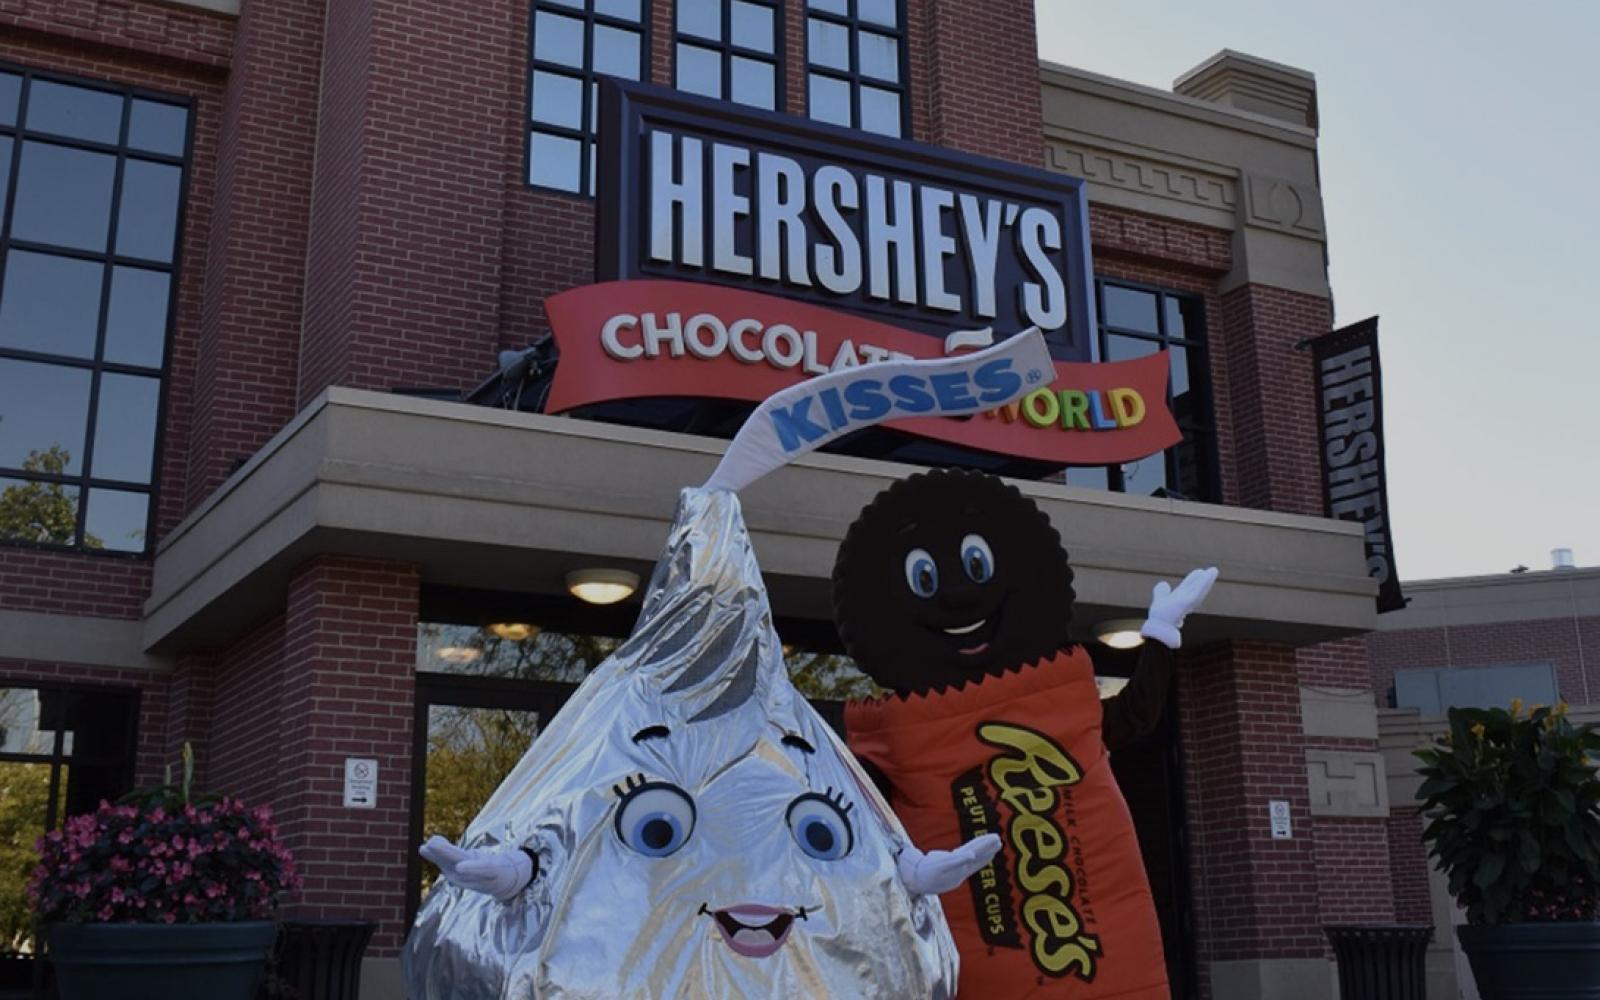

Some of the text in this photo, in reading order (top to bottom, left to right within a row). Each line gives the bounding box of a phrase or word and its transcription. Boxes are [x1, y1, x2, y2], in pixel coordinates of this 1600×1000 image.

[649, 129, 1068, 331] HERSHEY'S
[601, 311, 1146, 431] CHOCOLAT ORLD
[978, 722, 1100, 979] Reese's
[1071, 836, 1098, 925] CHOCOLATE
[984, 893, 1005, 935] CUPS
